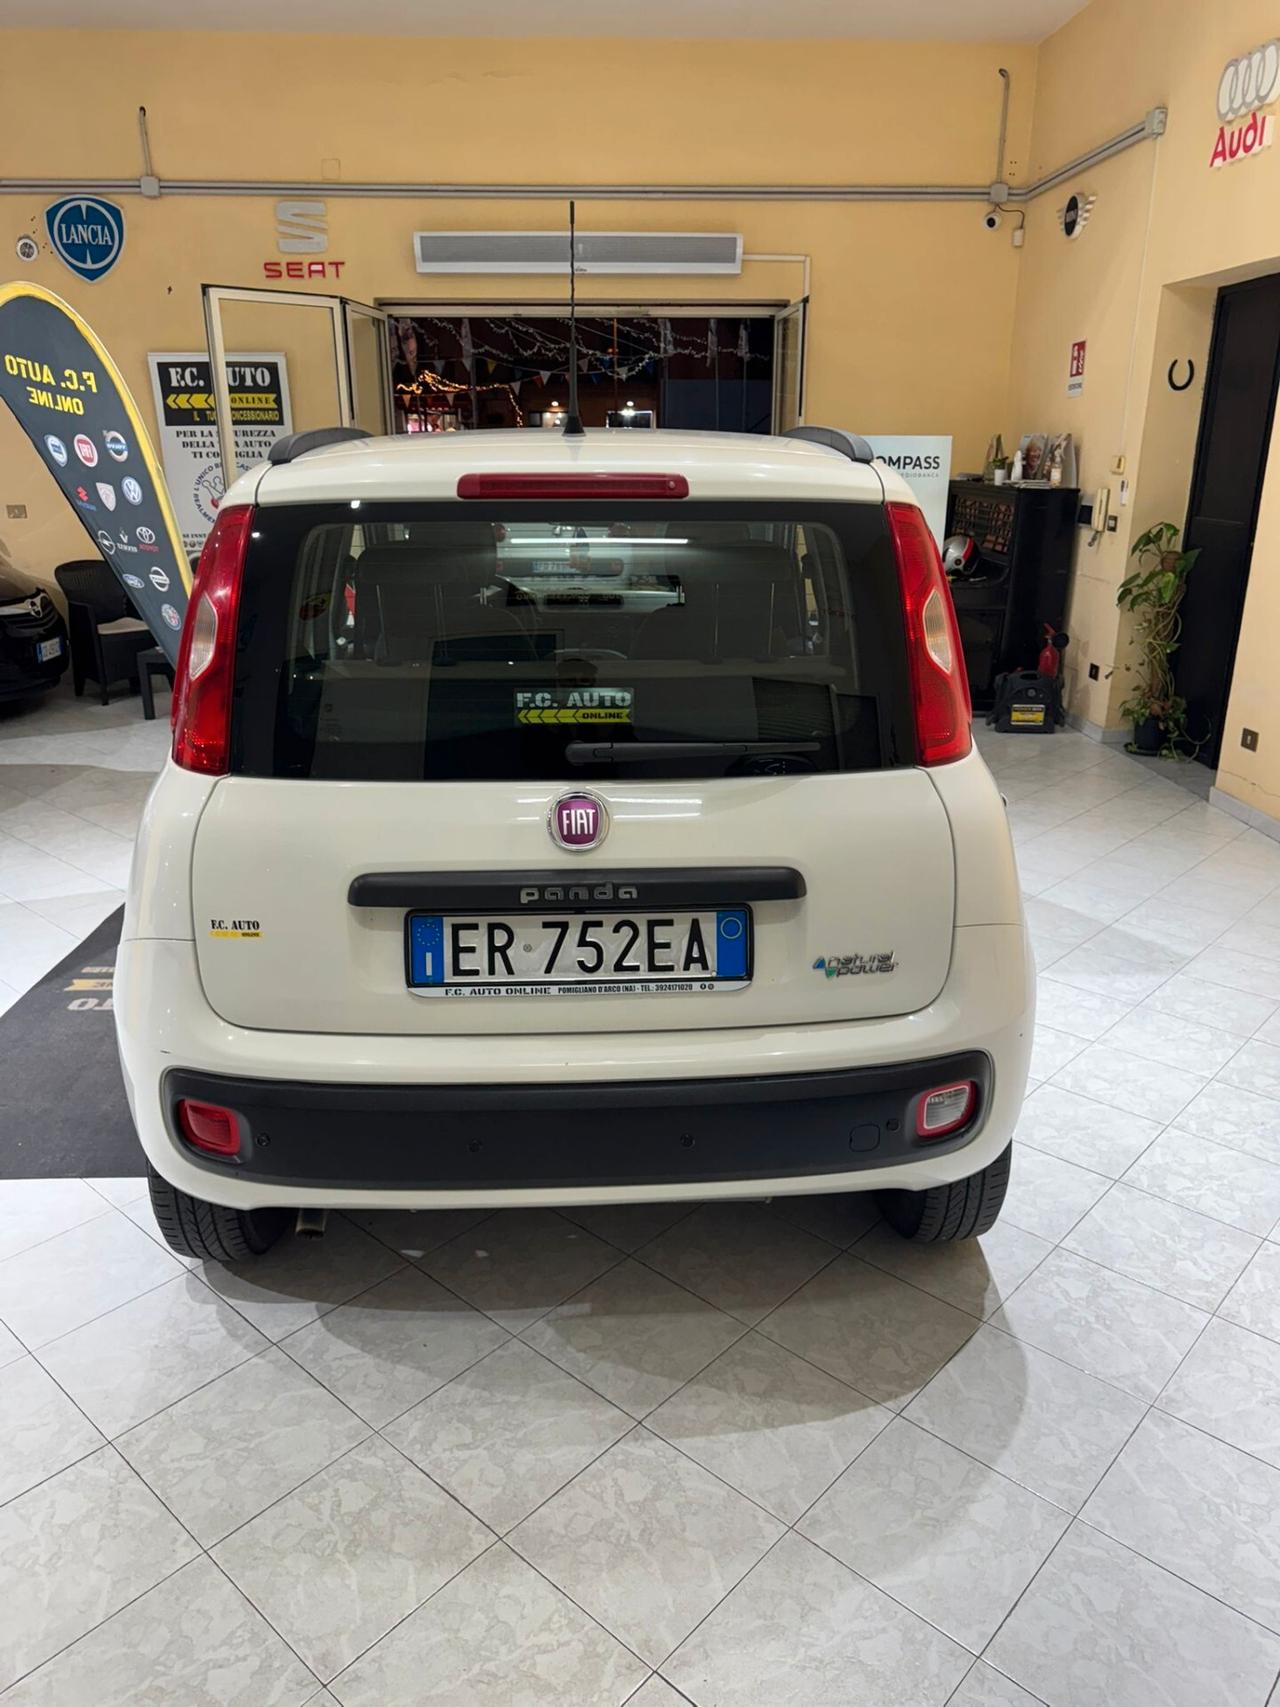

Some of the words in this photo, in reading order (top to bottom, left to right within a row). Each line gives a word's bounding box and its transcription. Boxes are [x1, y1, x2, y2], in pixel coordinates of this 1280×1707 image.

[1209, 111, 1266, 167] Audi
[60, 223, 113, 246] LANCIA
[264, 261, 345, 279] SEAT
[168, 367, 205, 387] F.C.
[225, 367, 271, 387] UTO
[231, 396, 271, 405] ONLINE
[232, 410, 279, 421] ONCESSIONARIO
[176, 430, 197, 438] PER
[200, 430, 213, 438] LA
[243, 440, 272, 448] AUTO
[192, 451, 203, 459] TI
[206, 450, 263, 459] COIGLIA
[876, 456, 940, 470] MPASS
[516, 693, 558, 707] F.C.
[567, 692, 632, 707] AUTO
[582, 711, 623, 719] ONLINE
[562, 808, 596, 835] FIAT
[520, 882, 638, 904] panda
[211, 919, 228, 930] F.C.
[231, 920, 260, 930] AUTO
[451, 923, 515, 977] ER
[541, 918, 710, 974] 752EA
[469, 988, 502, 996] AUTO
[505, 986, 551, 995] ONLINE
[558, 986, 597, 994] POMIGLIANO
